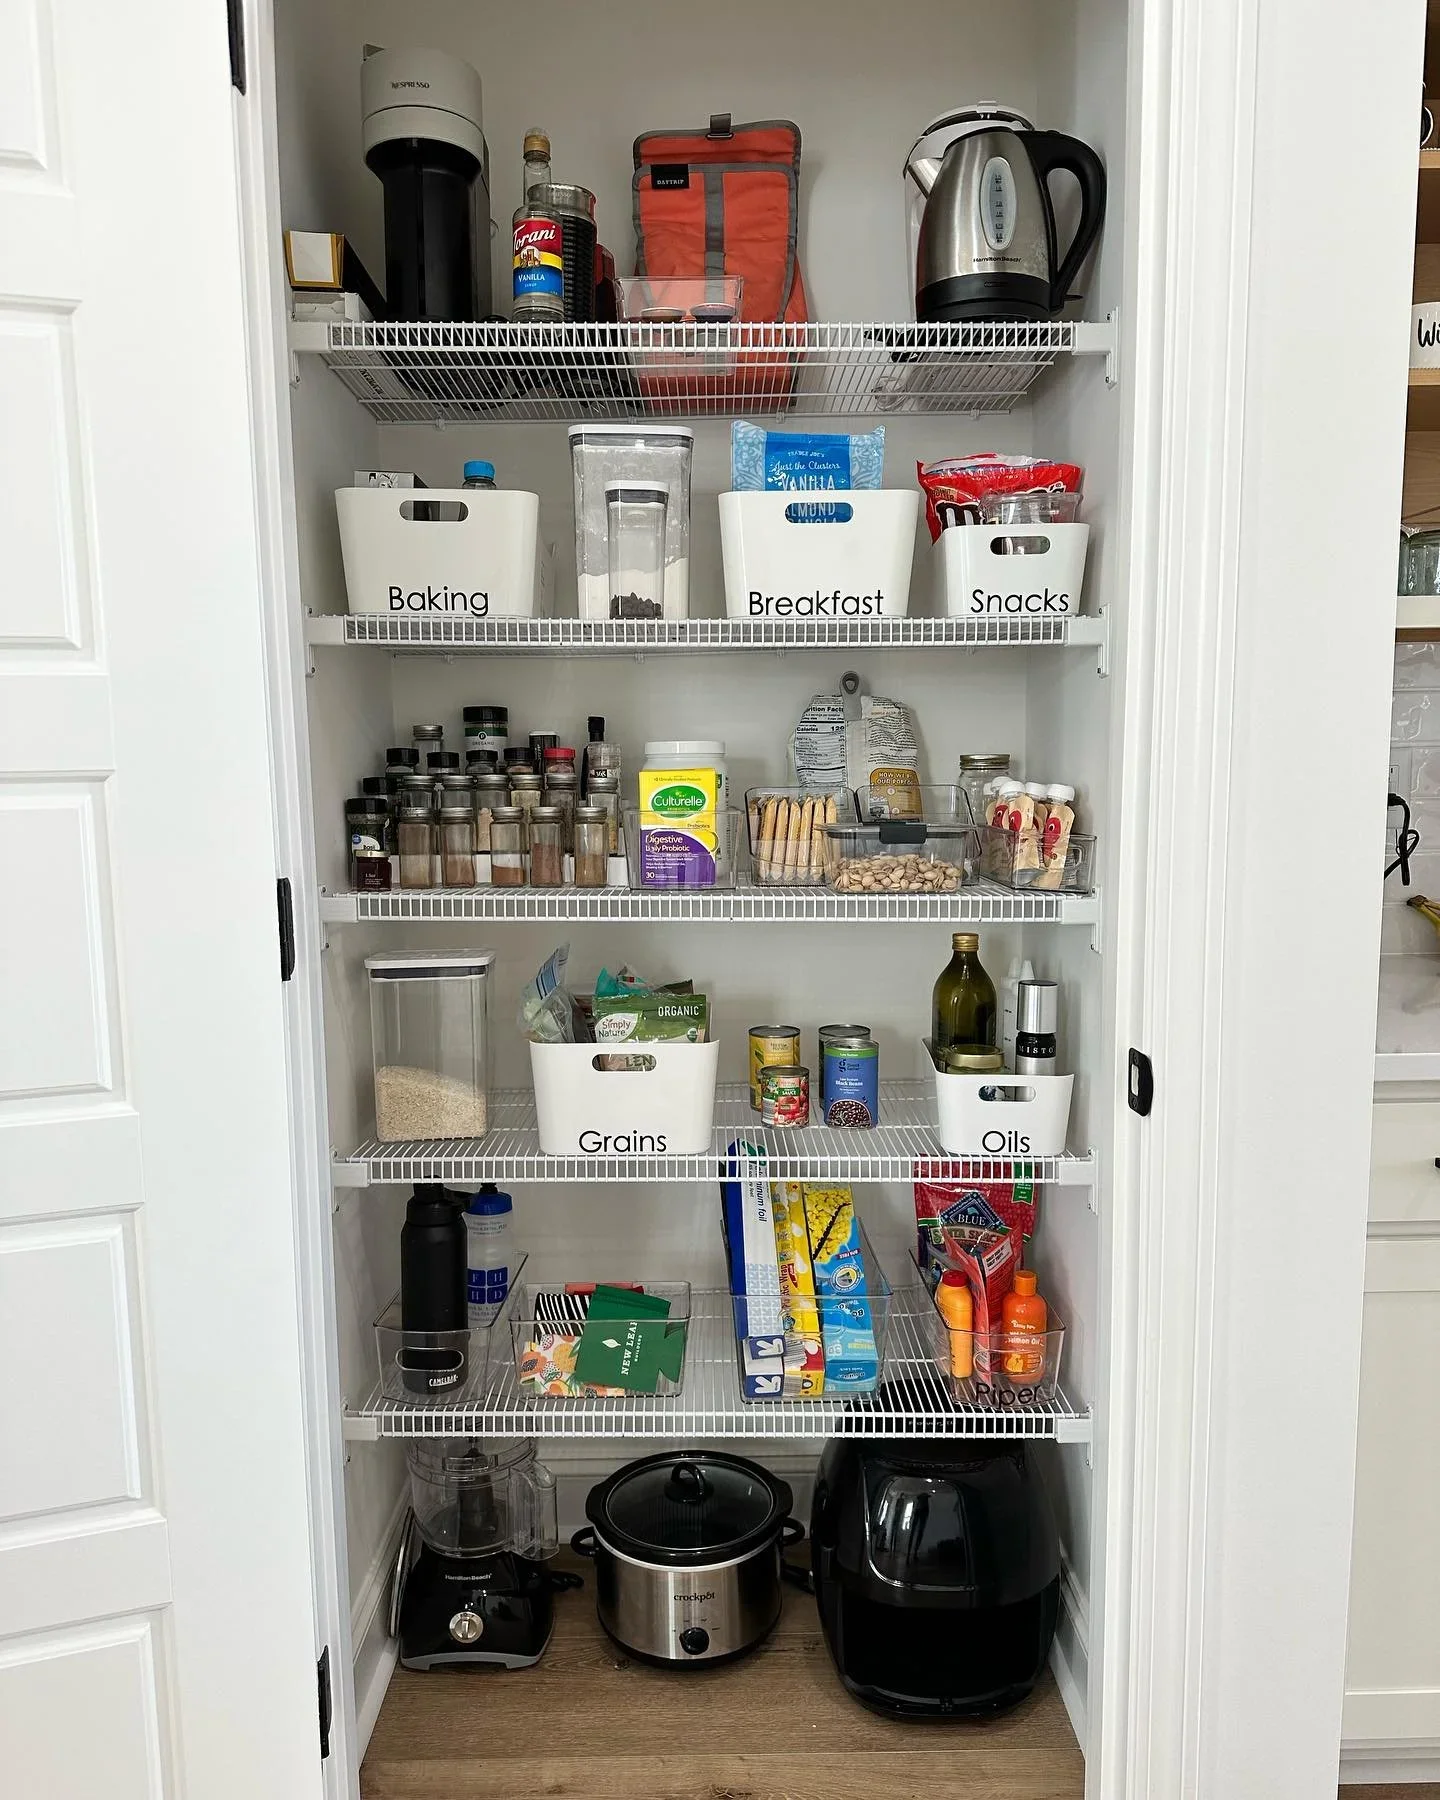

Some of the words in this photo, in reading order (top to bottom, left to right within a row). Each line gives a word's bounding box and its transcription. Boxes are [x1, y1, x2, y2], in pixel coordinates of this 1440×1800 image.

[512, 223, 556, 254] Torani
[518, 273, 545, 282] VANILLA
[795, 461, 806, 470] the
[781, 474, 835, 491] VANILLA
[388, 585, 489, 617] Baking
[748, 589, 884, 616] Breakfast
[970, 588, 1069, 613] Snacks
[653, 795, 703, 807] Culturelle
[646, 834, 683, 845] Digestive
[662, 844, 690, 852] Probiotic
[658, 1005, 699, 1017] ORGANIC
[602, 1018, 631, 1030] Simply
[578, 1130, 667, 1154] Grains
[982, 1129, 1031, 1154] Oils
[957, 1213, 986, 1226] BLUE
[780, 1264, 790, 1284] Wrap
[620, 1348, 632, 1376] NEW
[975, 1382, 1041, 1410] Piper
